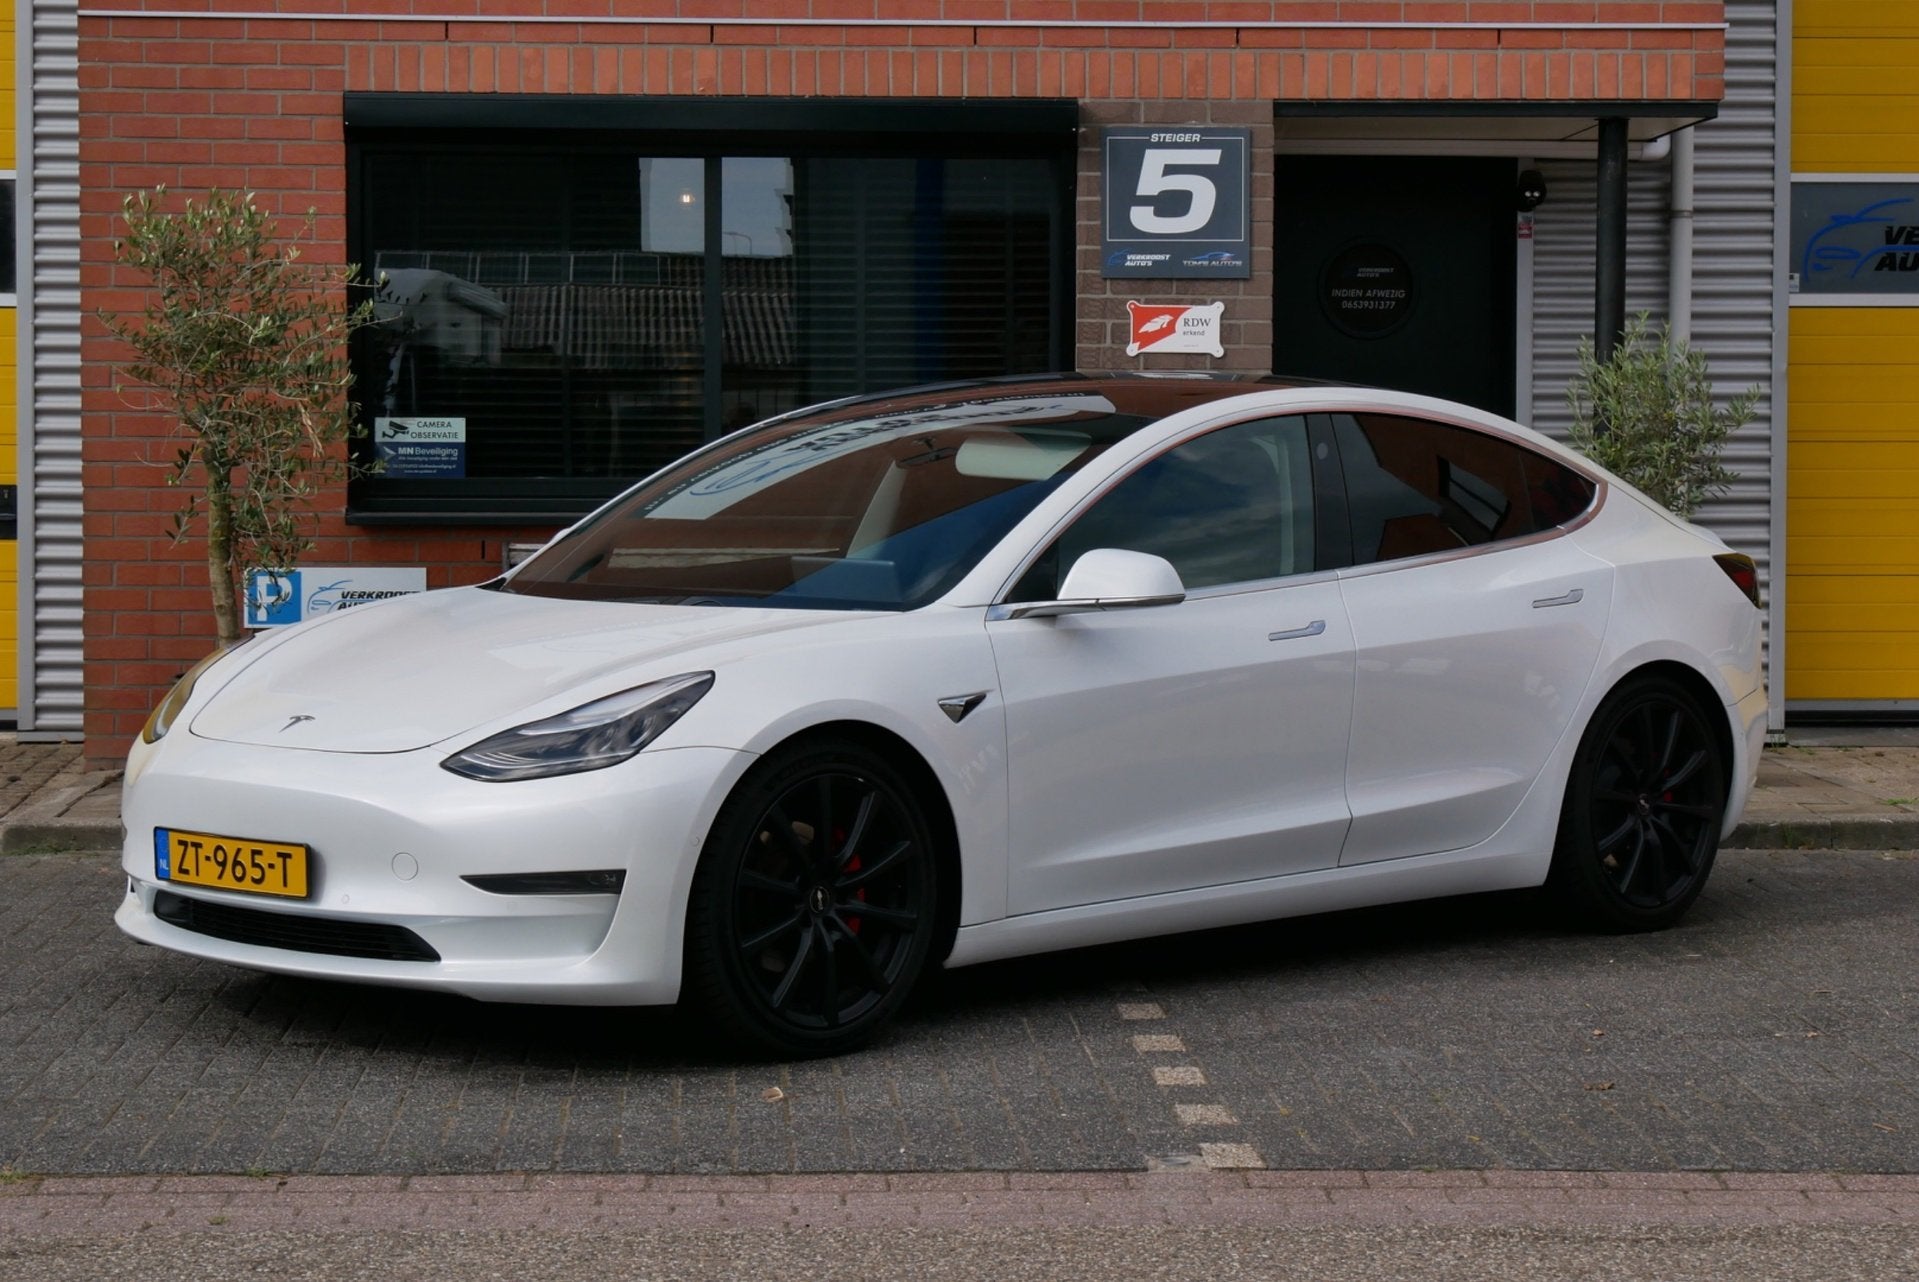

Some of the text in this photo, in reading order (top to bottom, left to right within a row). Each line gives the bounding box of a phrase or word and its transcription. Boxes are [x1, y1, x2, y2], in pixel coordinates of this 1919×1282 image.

[1150, 133, 1201, 142] STEIGER
[1129, 149, 1222, 234] 5
[1332, 289, 1406, 298] INDIEN AFWEZIG
[1183, 317, 1211, 327] RDW
[410, 431, 459, 439] OBSERVATIE
[398, 447, 459, 456] MN Beveiliging
[159, 858, 169, 870] NL
[177, 839, 293, 888] ZT-965-T
